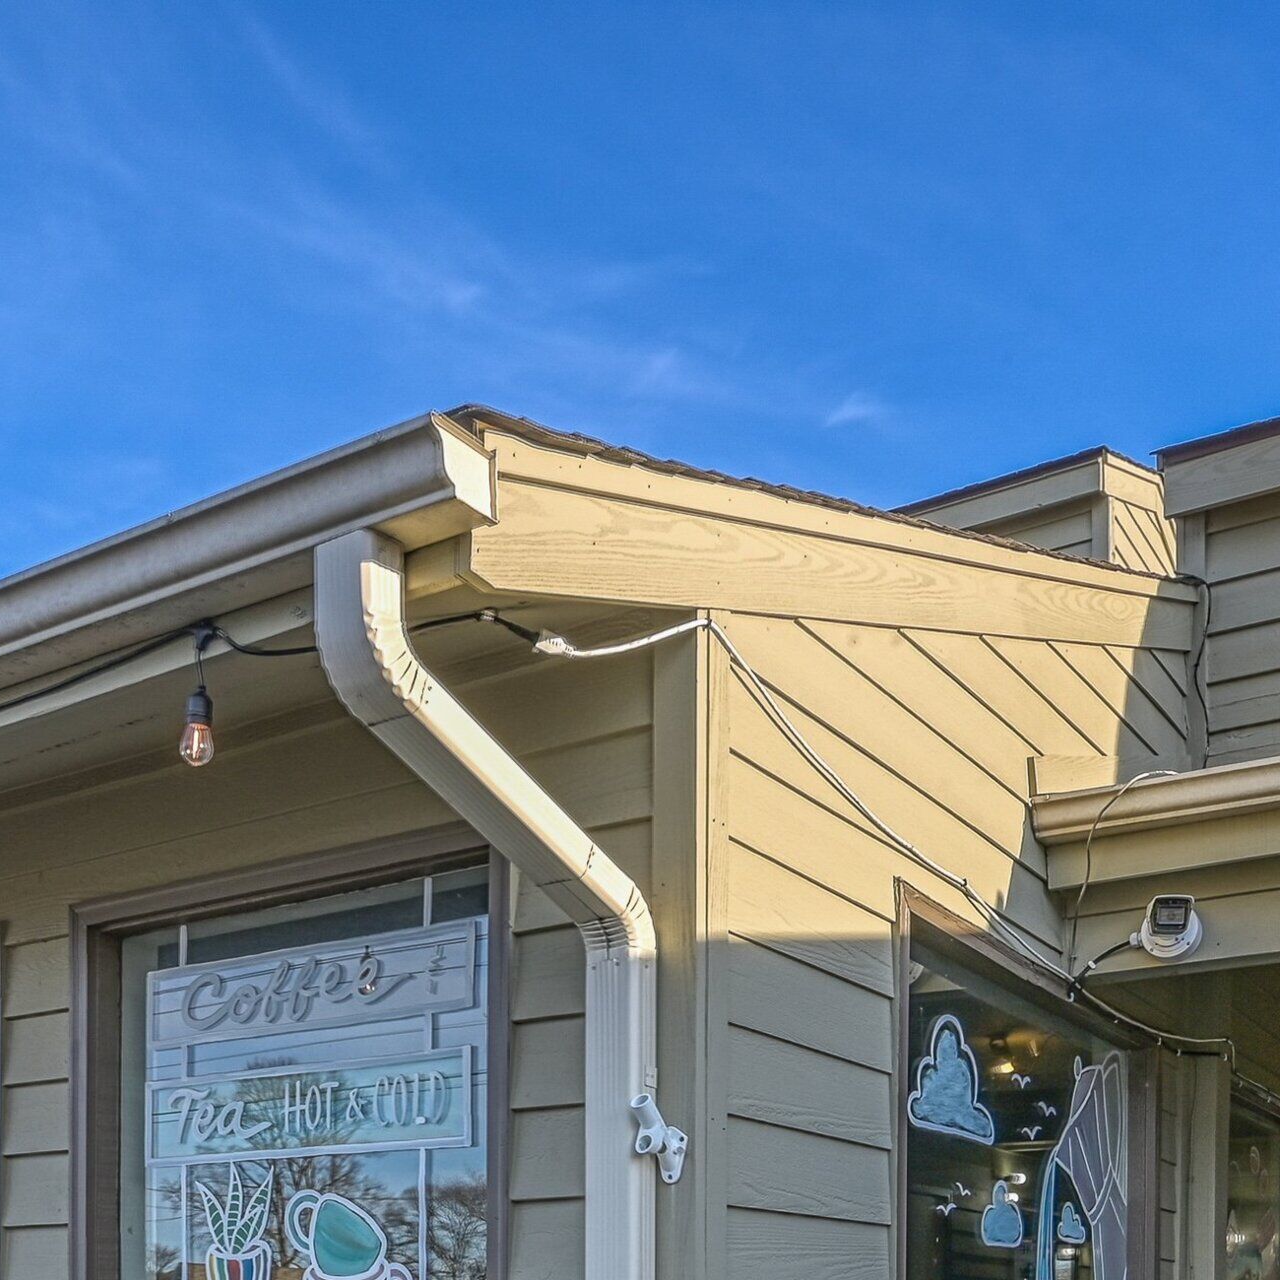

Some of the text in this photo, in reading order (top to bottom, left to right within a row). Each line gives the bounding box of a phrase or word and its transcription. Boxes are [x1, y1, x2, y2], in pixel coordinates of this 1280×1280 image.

[181, 956, 415, 1031] Coffee
[169, 1070, 453, 1145] Tea HOT & COLD
